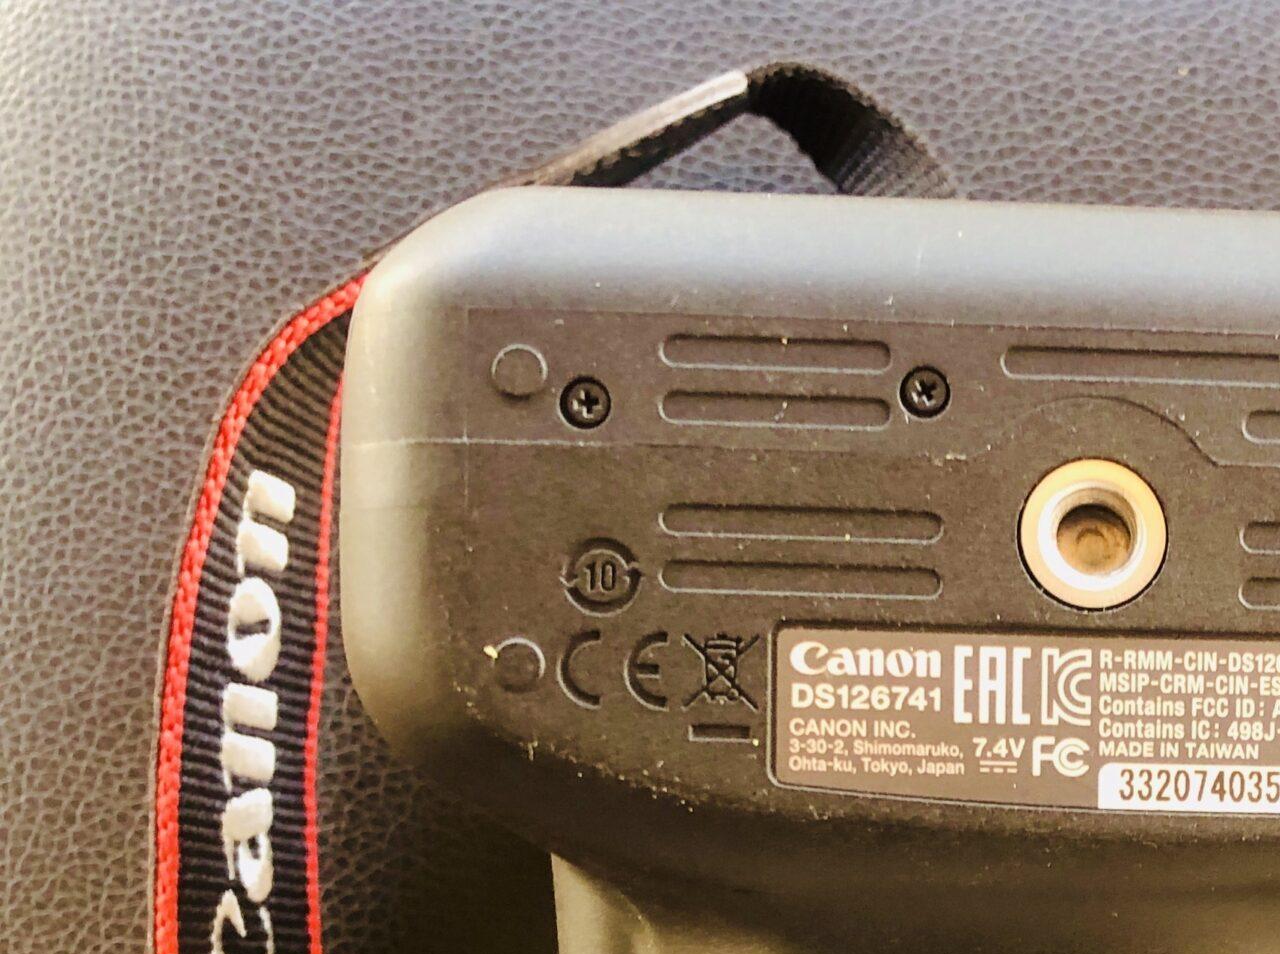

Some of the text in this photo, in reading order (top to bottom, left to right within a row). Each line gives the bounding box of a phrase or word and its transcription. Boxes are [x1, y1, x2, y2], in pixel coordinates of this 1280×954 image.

[789, 641, 942, 678] Canon
[790, 682, 942, 712] DS126741
[1098, 695, 1185, 717] Contains
[1191, 697, 1229, 717] FCC
[788, 717, 916, 738] CANON INC.
[1098, 717, 1185, 740] Contains
[788, 738, 964, 759] 3-30-2, Shimomaruko,
[972, 736, 1026, 758] 7.4V
[1098, 740, 1259, 760] MADE IN TAIWAN
[788, 756, 965, 777] Ohta-ku, Tokyo, Japan
